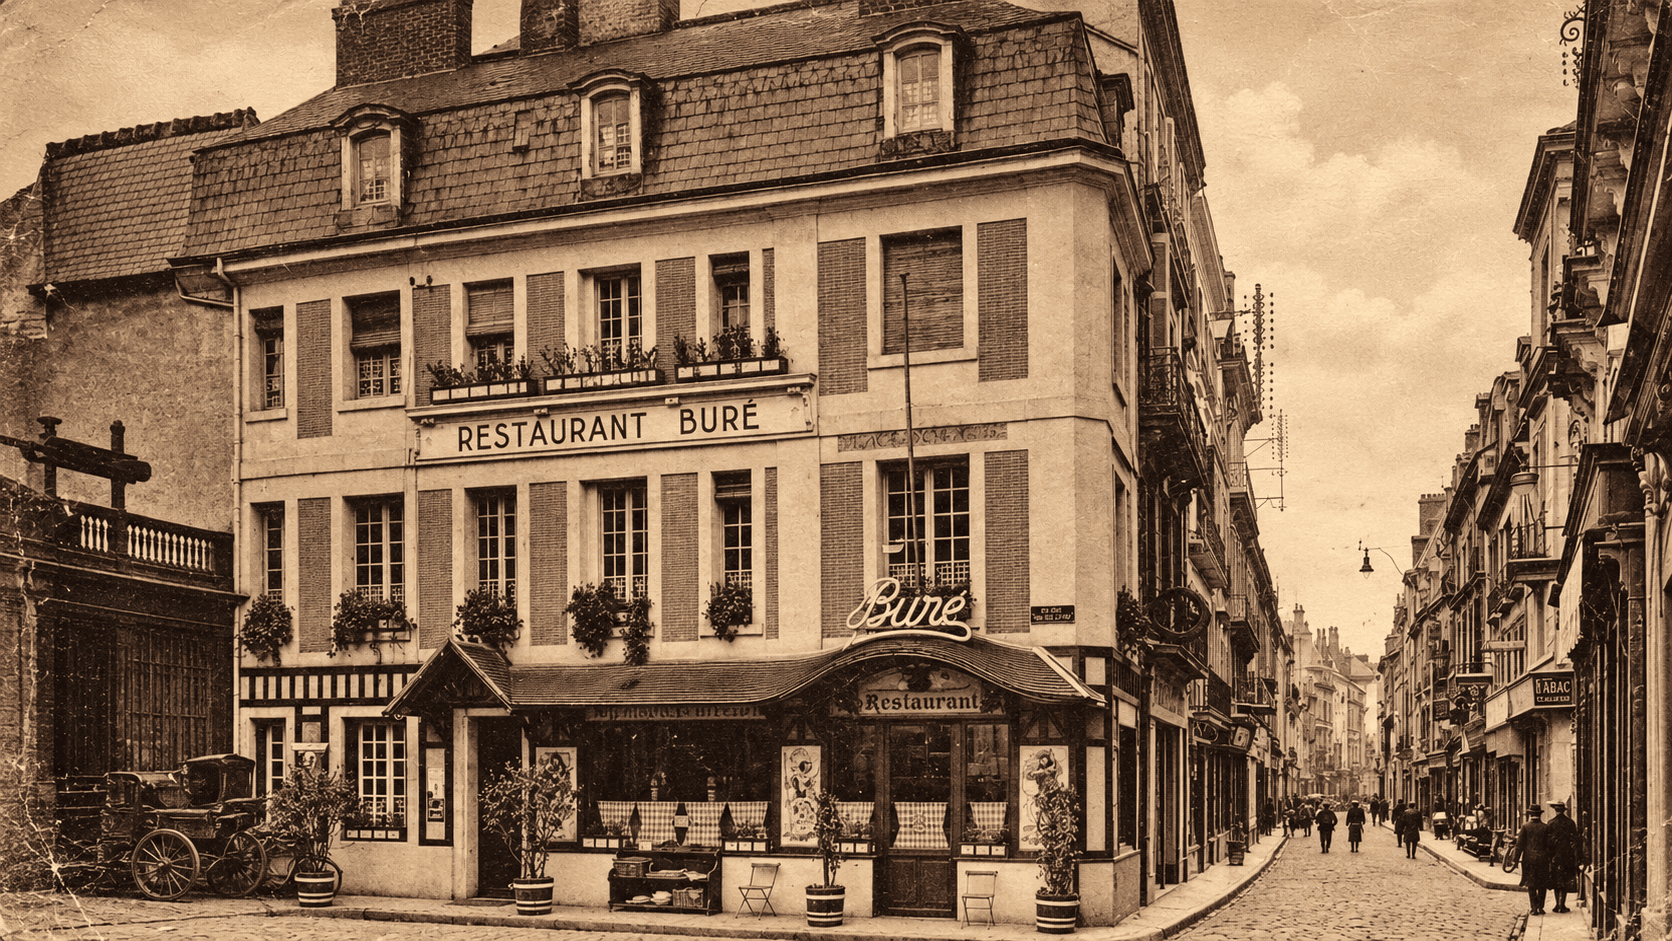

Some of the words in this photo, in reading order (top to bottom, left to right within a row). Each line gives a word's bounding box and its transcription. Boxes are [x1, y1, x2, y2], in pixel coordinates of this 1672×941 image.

[458, 412, 647, 452] RESTAURANT
[679, 399, 760, 435] BURÉ
[846, 577, 972, 645] Buré
[864, 692, 980, 715] Restaurant
